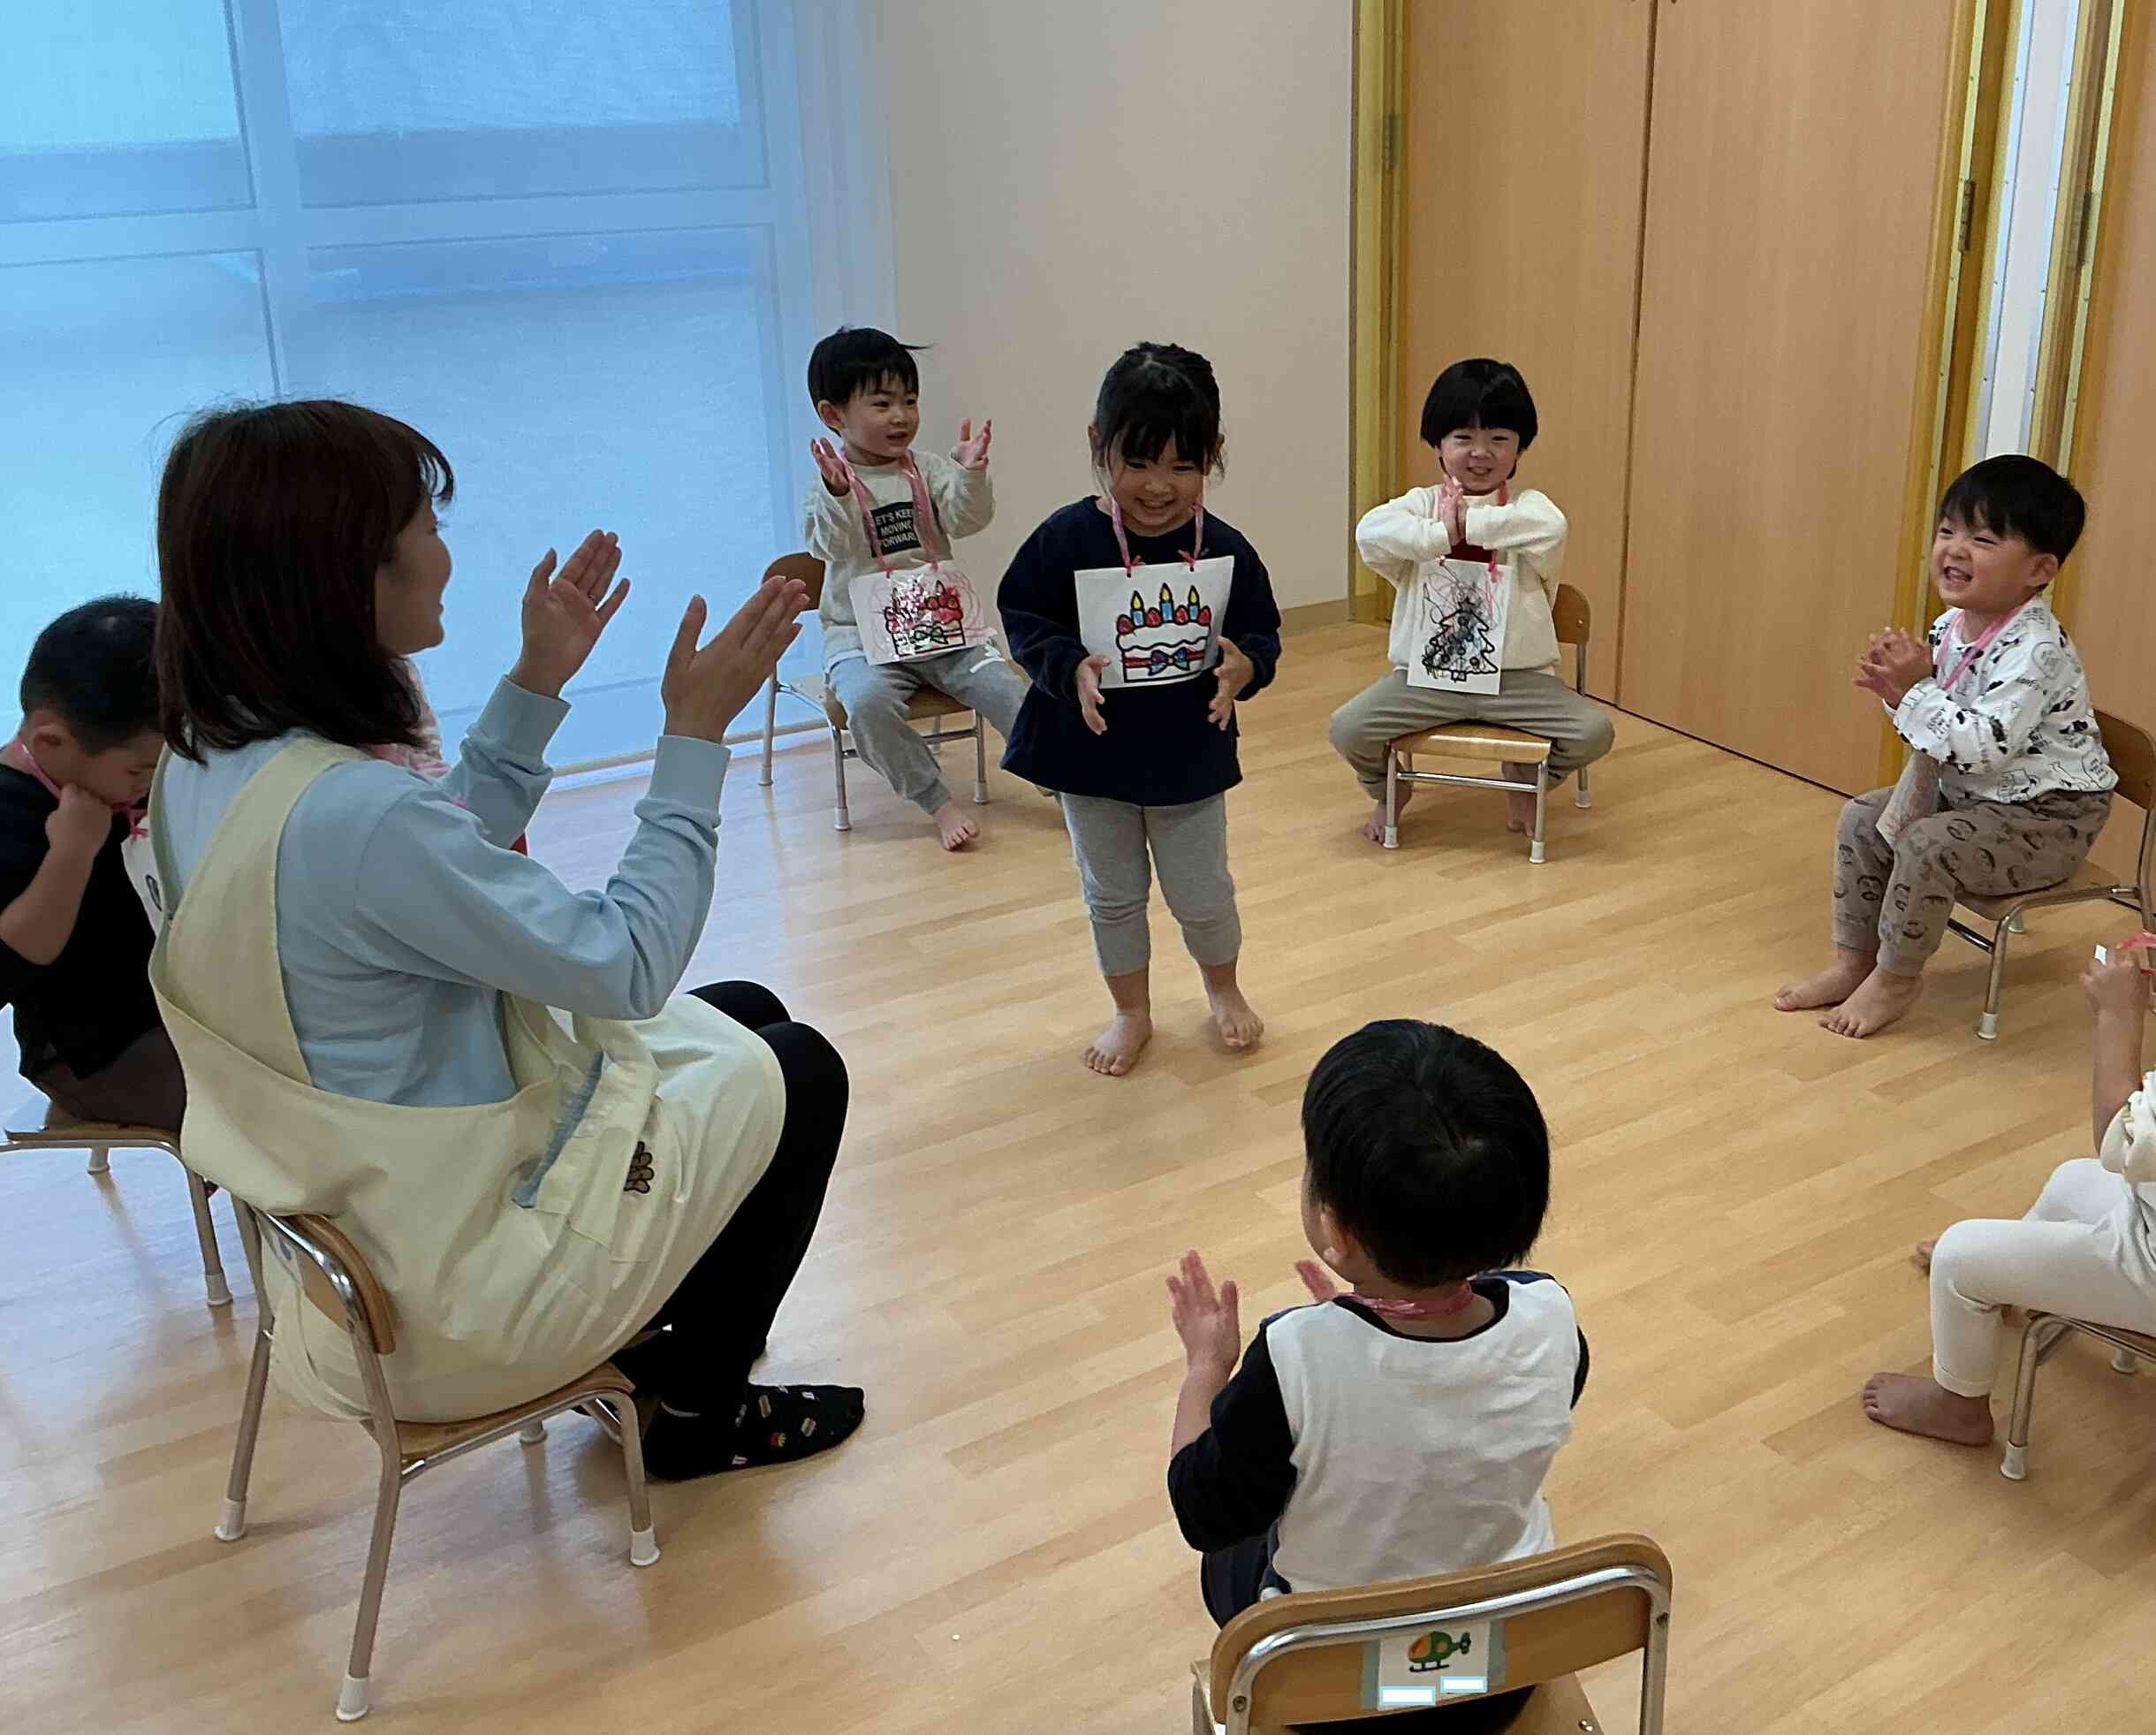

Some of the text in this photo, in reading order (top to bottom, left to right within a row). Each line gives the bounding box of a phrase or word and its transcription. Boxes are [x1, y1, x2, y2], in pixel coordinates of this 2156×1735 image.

[876, 509, 913, 526] ET'S KEE
[883, 532, 916, 547] ORWAR
